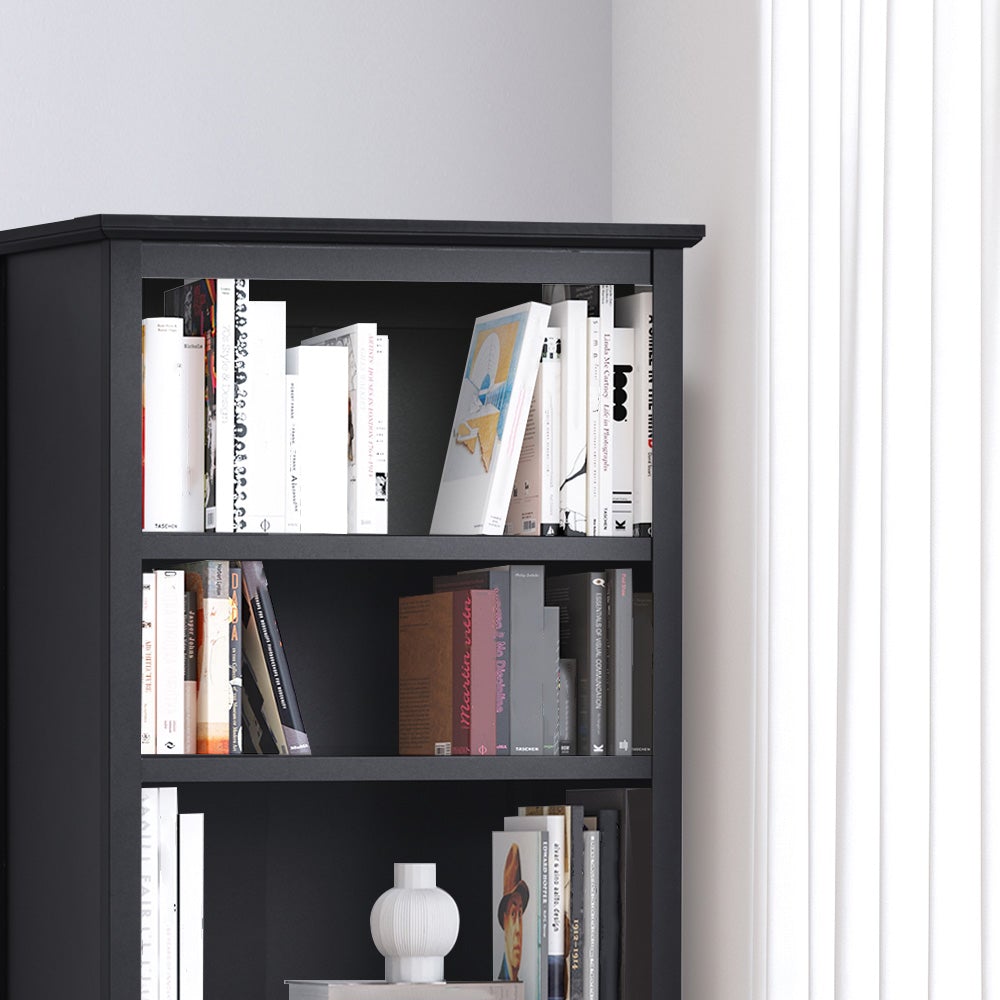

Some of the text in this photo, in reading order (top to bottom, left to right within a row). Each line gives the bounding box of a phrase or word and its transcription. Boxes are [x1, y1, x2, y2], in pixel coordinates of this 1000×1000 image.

[219, 344, 231, 371] Style
[603, 334, 611, 355] Linda
[219, 383, 231, 424] Design
[231, 573, 239, 641] DADA
